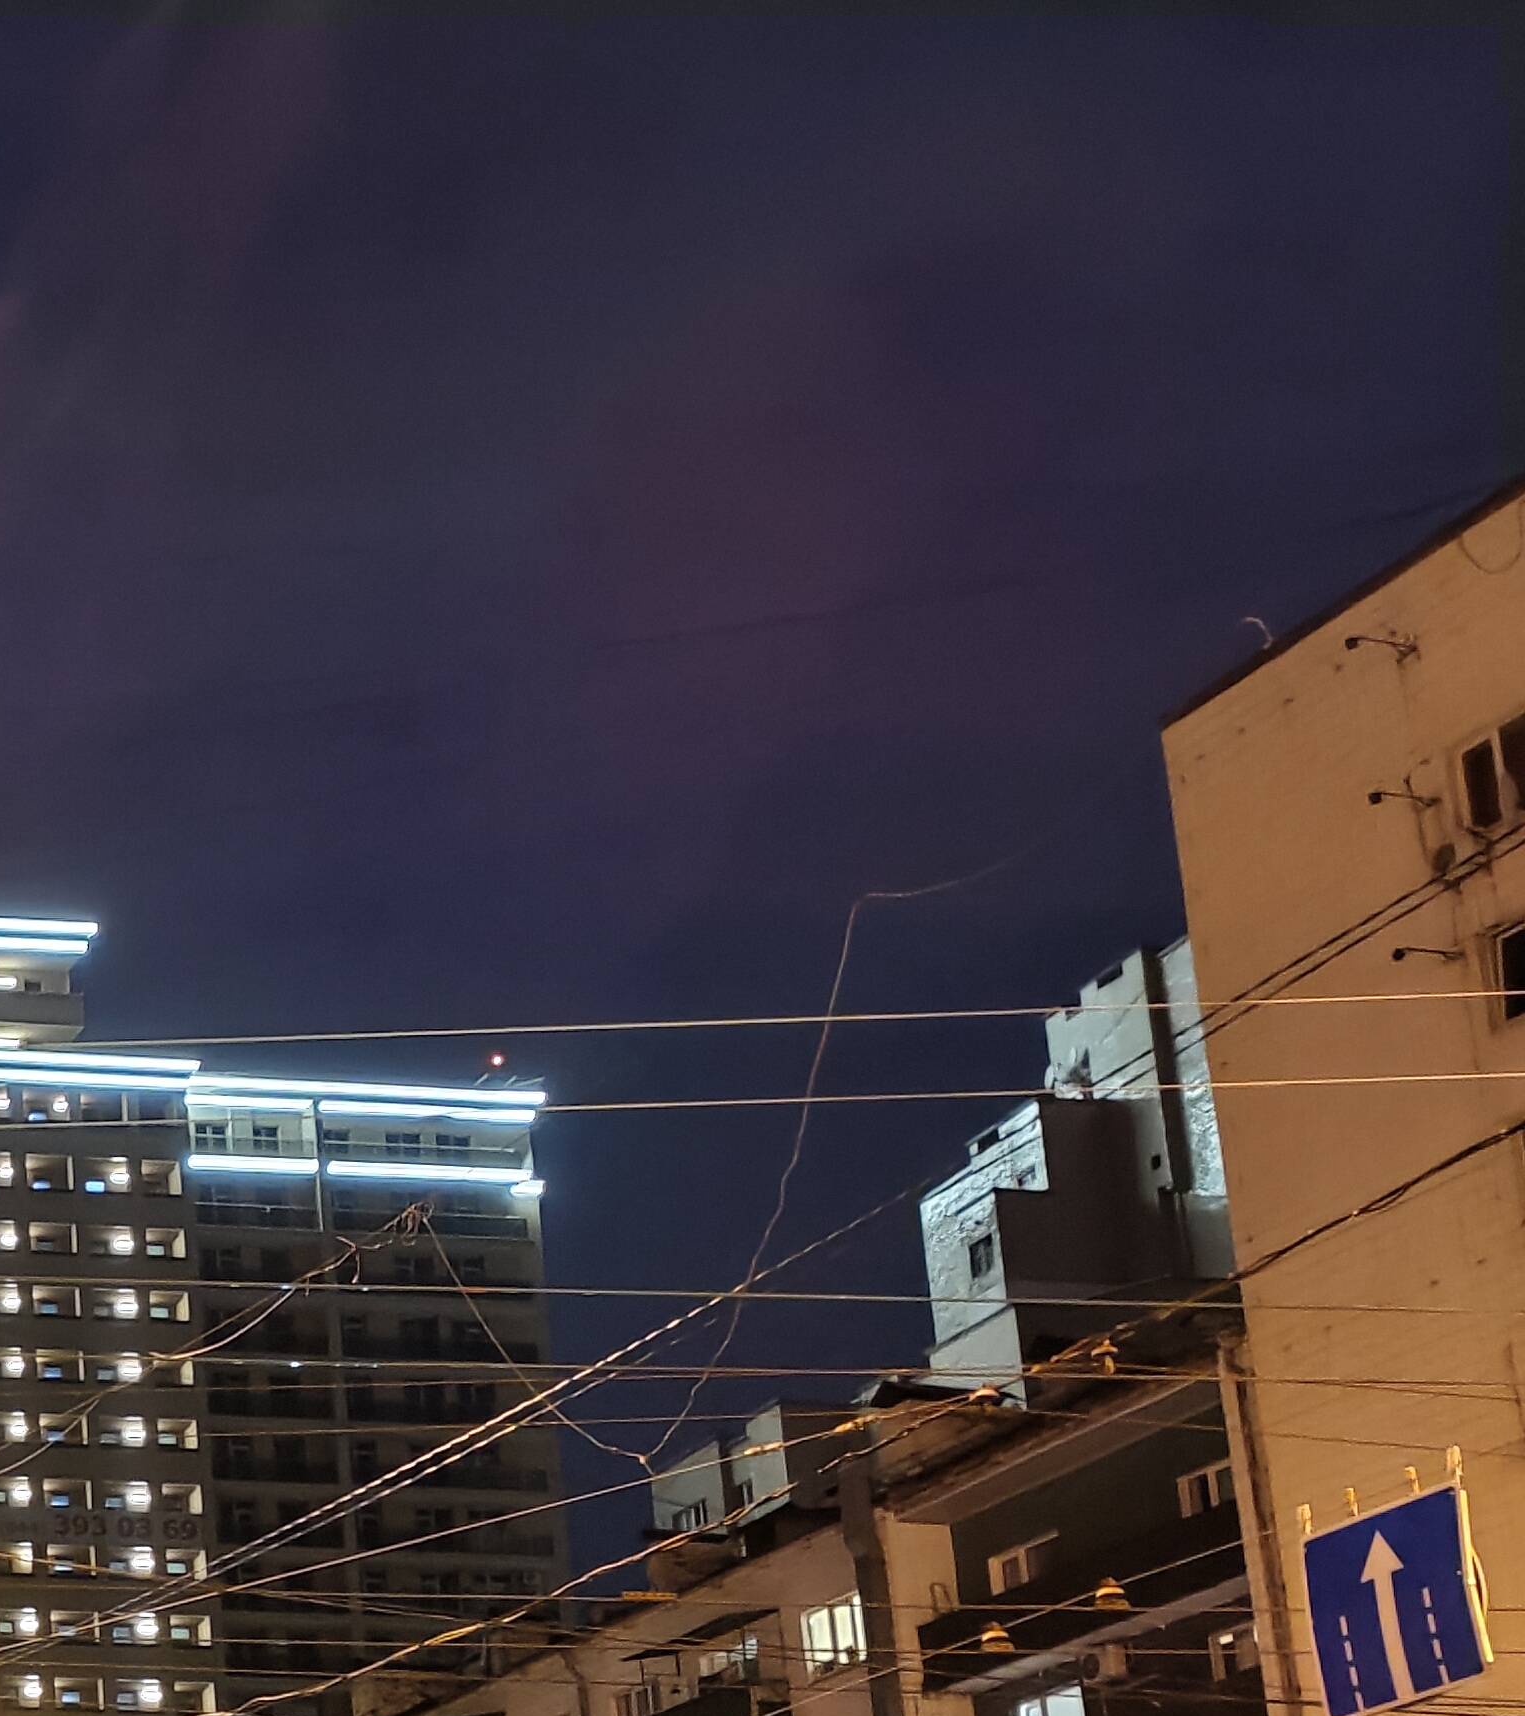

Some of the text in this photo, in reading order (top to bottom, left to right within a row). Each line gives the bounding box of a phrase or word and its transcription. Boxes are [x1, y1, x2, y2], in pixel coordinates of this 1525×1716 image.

[54, 1514, 107, 1537] 393
[116, 1515, 152, 1539] 03
[162, 1518, 198, 1540] 69
